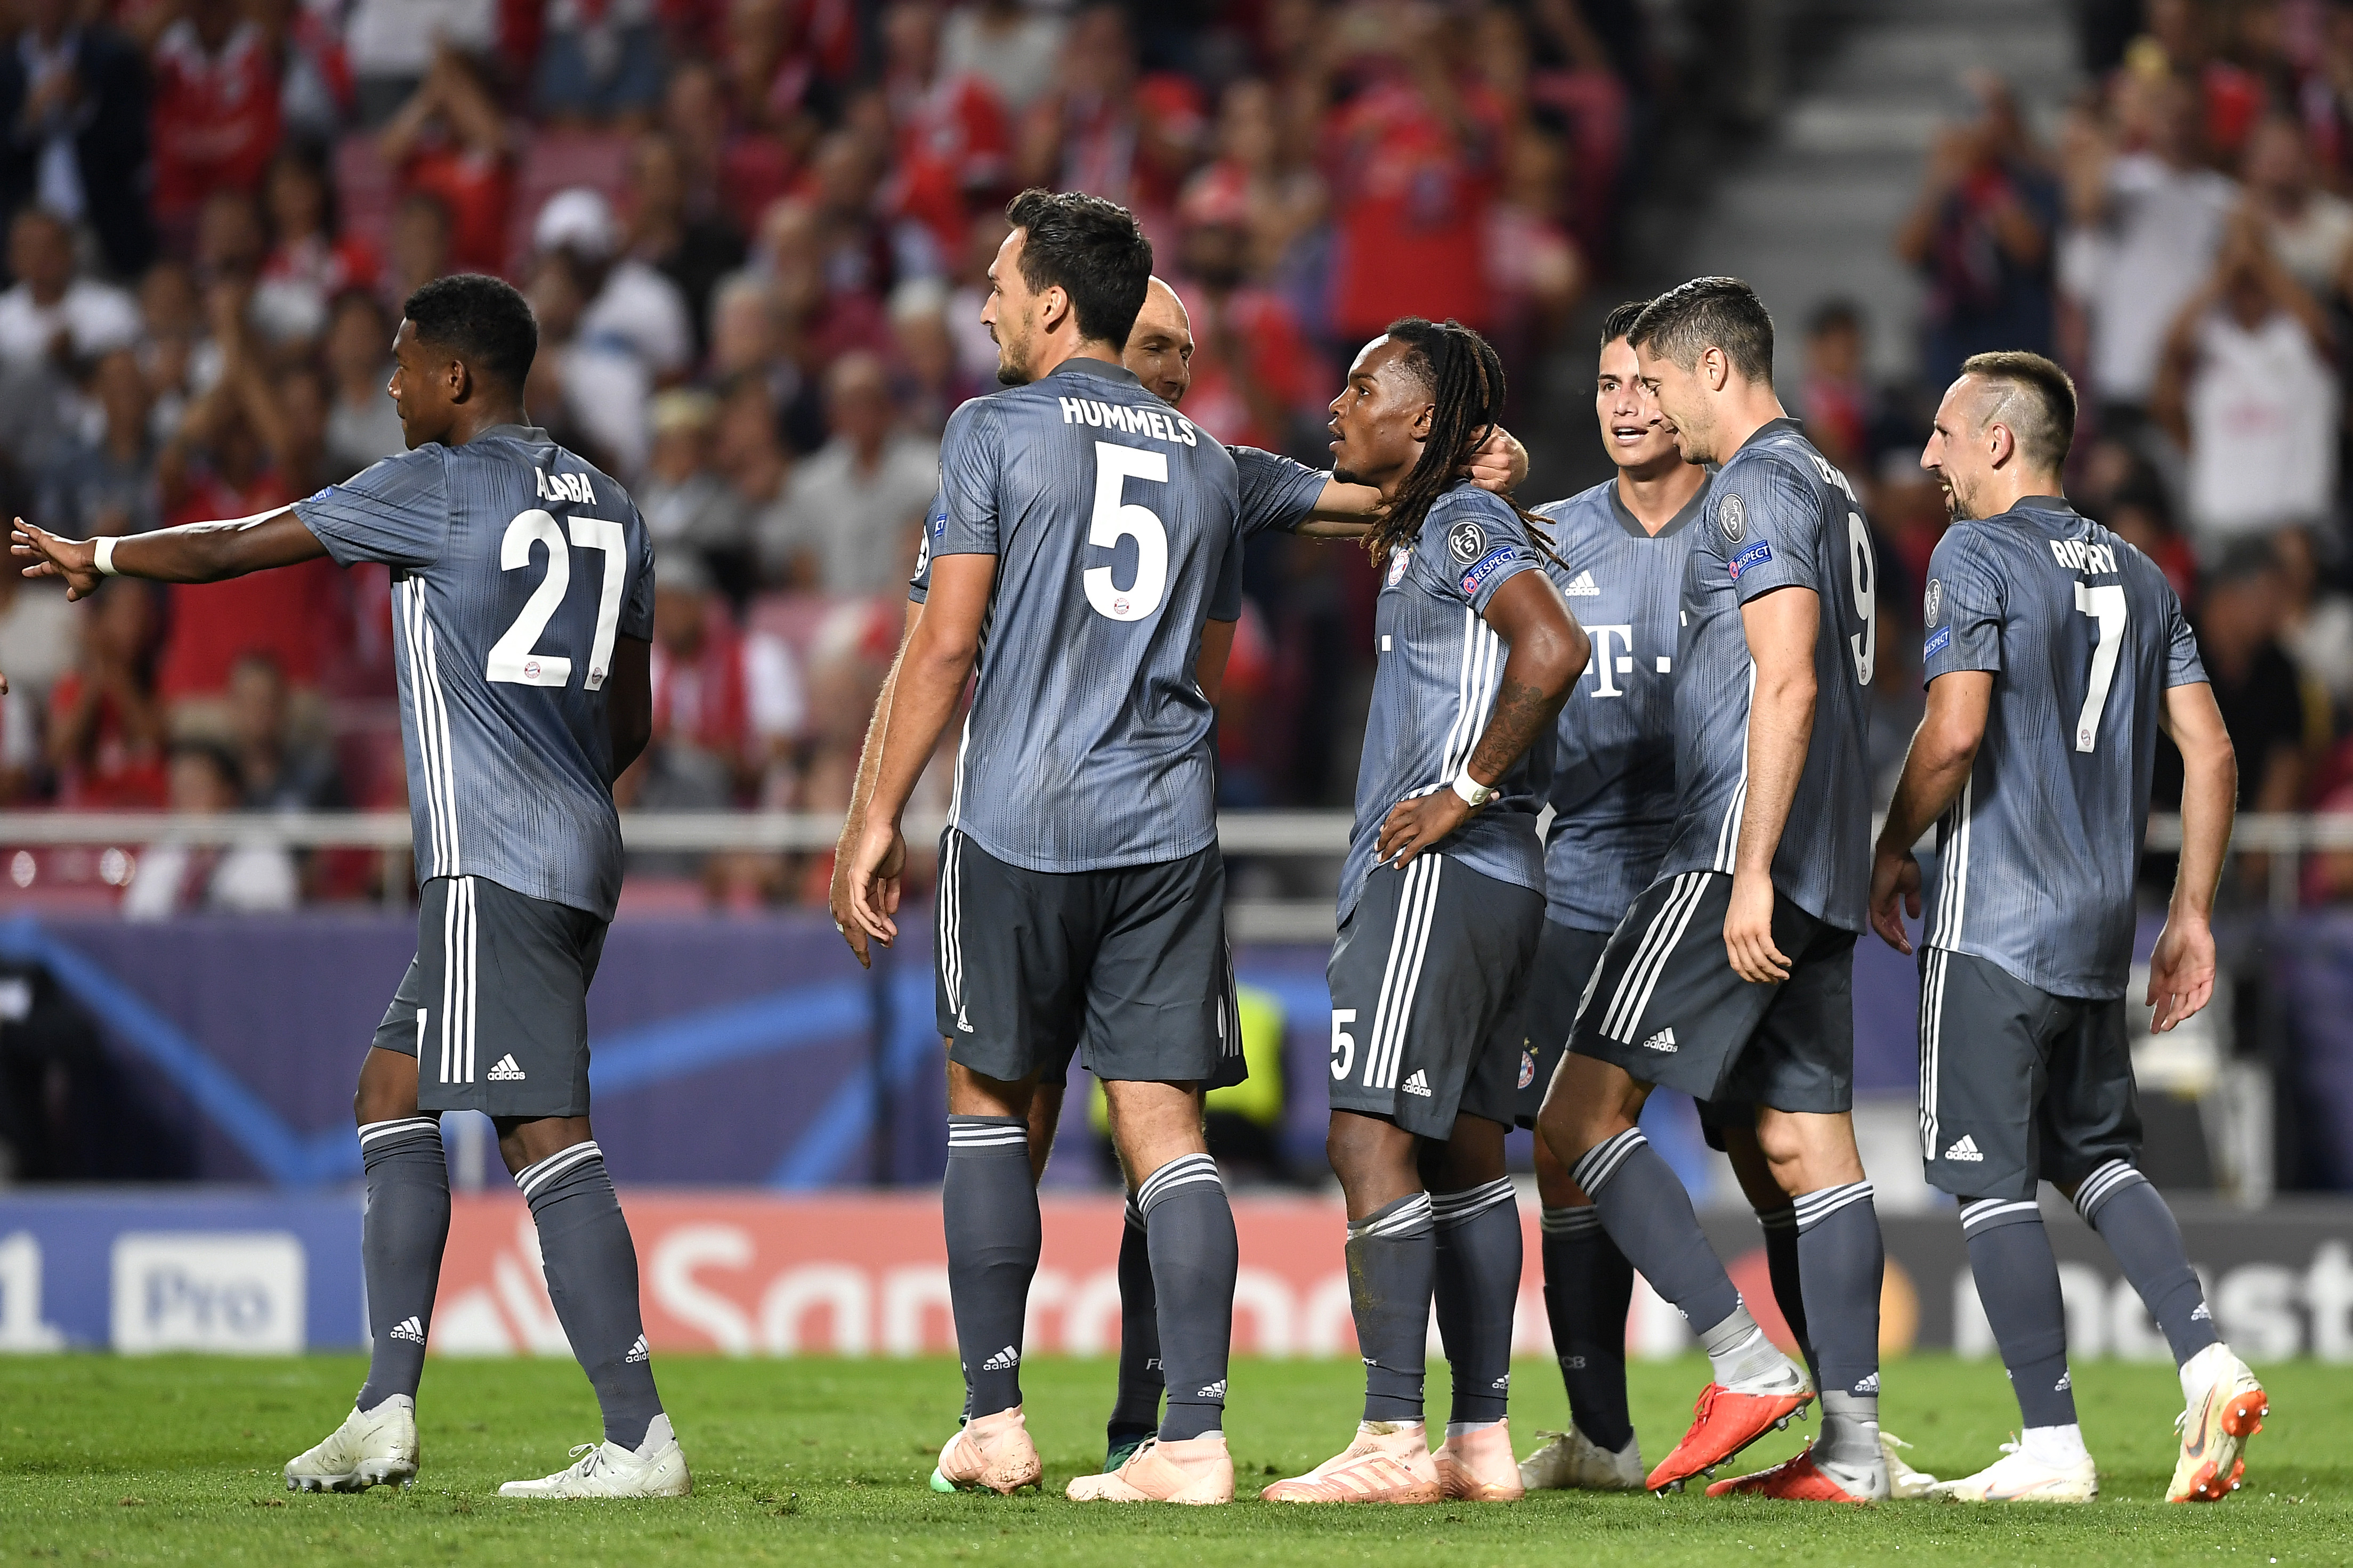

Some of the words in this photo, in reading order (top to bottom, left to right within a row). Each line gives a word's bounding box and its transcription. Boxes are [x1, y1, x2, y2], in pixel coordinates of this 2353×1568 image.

[1058, 396, 1198, 447] HUMMELS
[535, 466, 597, 505] ALABA
[1730, 516, 1737, 531] 5
[1083, 441, 1168, 622] 5
[1464, 540, 1475, 553] 5
[1736, 546, 1768, 570] RESPECT
[1473, 550, 1515, 582] RESPECT
[1565, 587, 1600, 596] adidas
[1848, 512, 1875, 686] 9
[486, 509, 627, 692] 27
[1931, 602, 1936, 615] 5
[1925, 631, 1949, 654] RESPECT
[1582, 625, 1632, 697] T
[2074, 581, 2127, 753] 7
[1643, 1040, 1678, 1052] adidas
[487, 1070, 526, 1080] adidas
[1402, 1084, 1432, 1097] adidas
[1945, 1150, 1984, 1161] adidas
[390, 1331, 425, 1345] adidas
[1198, 1389, 1225, 1399] adid
[1855, 1384, 1879, 1392] adid
